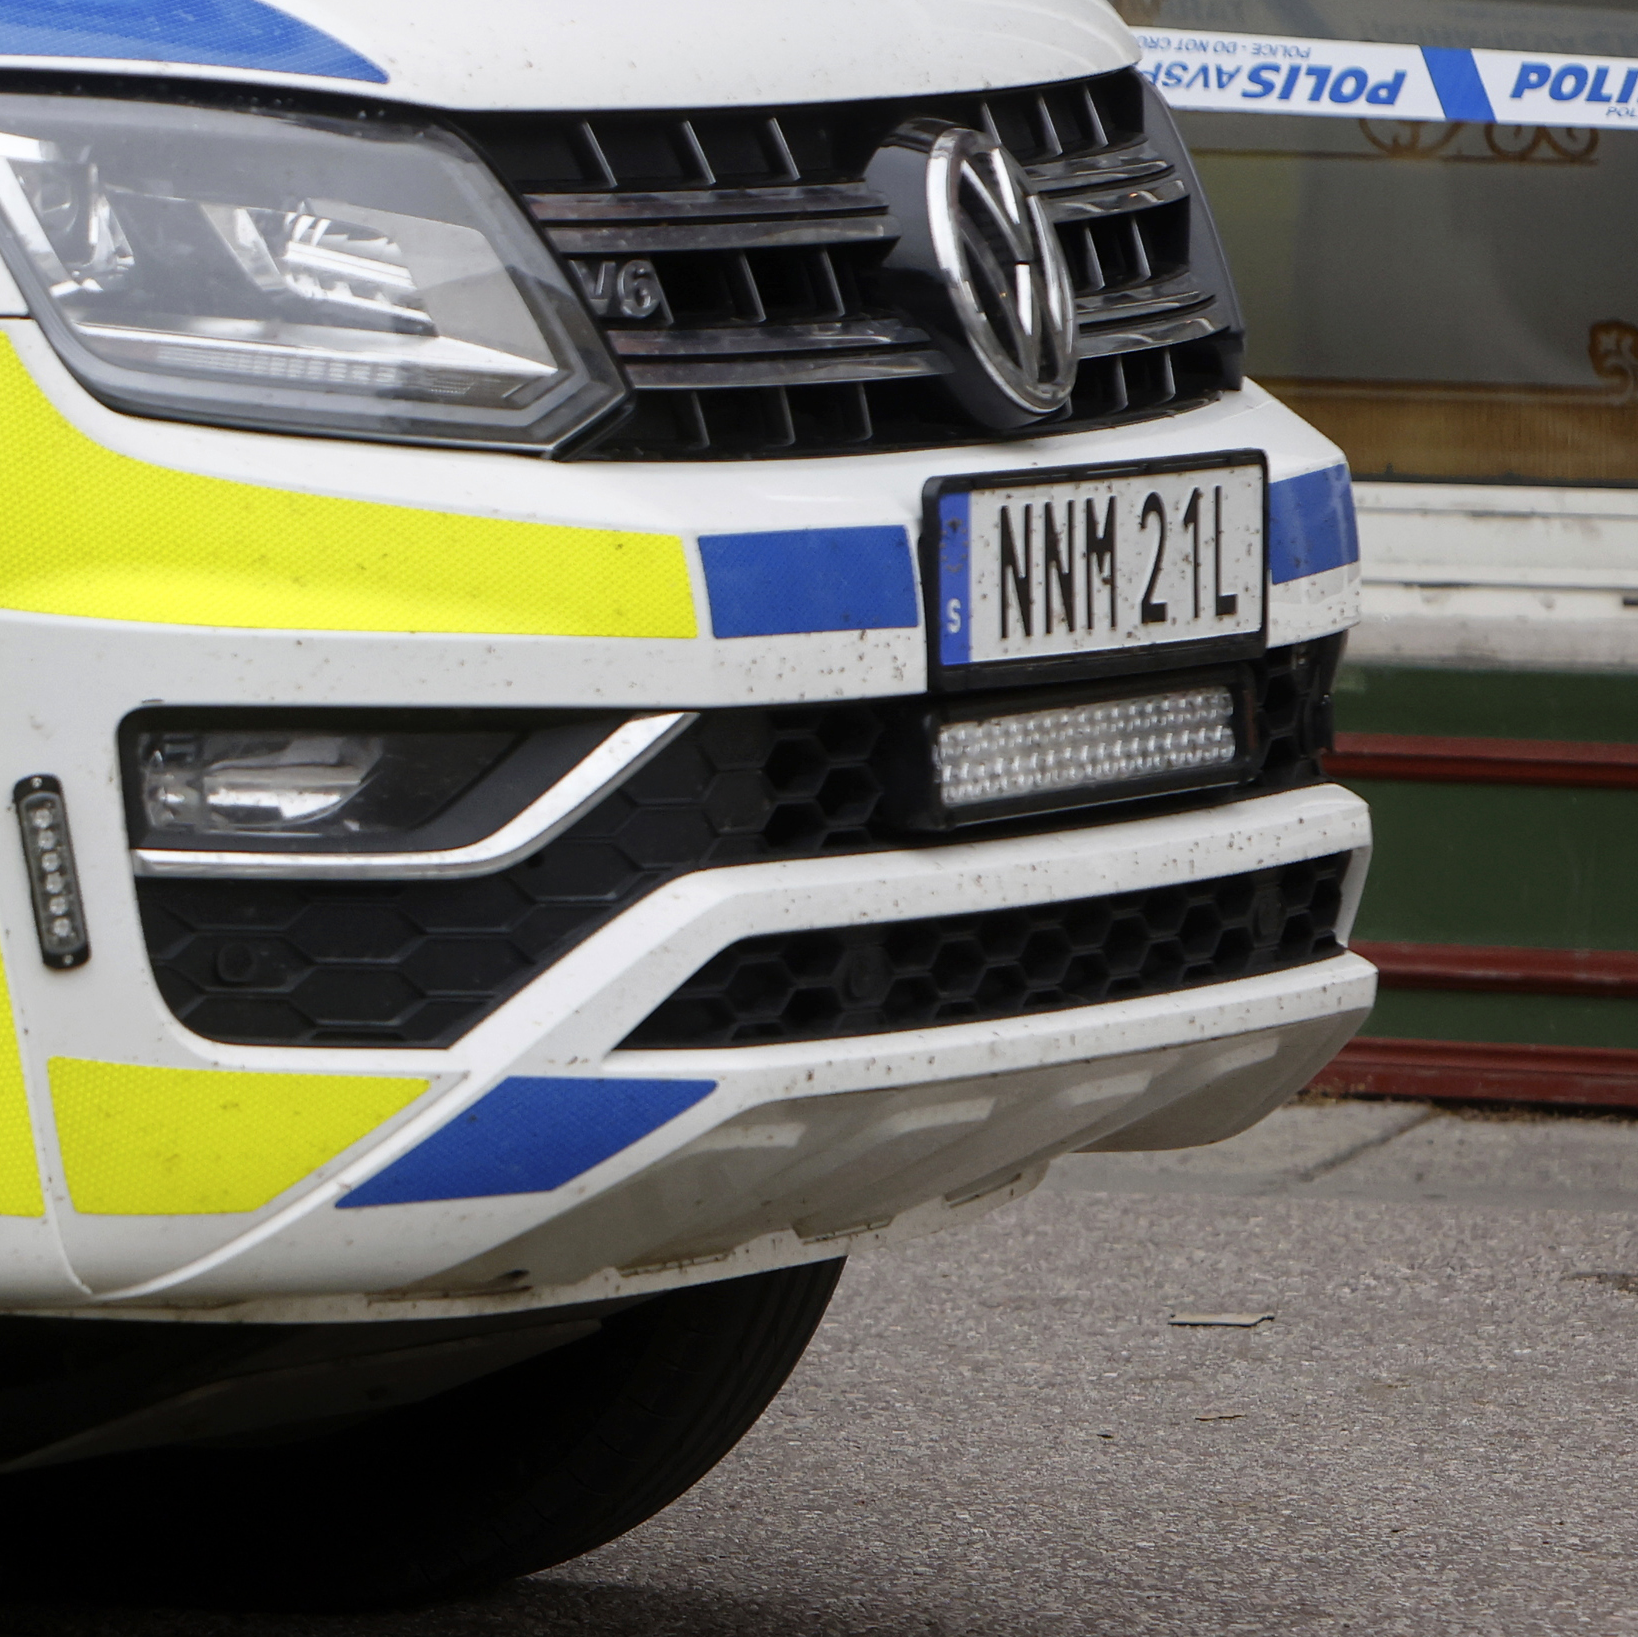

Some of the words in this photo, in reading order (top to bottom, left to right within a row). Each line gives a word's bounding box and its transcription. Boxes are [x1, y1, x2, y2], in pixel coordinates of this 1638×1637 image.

[1176, 38, 1210, 53] NOT
[1213, 40, 1237, 54] DO
[1251, 42, 1312, 60] POLICE
[1241, 61, 1407, 105] POLIS
[568, 258, 662, 319] V6
[1000, 494, 1117, 640] NNM
[1139, 484, 1238, 624] 21L
[946, 597, 962, 635] S
